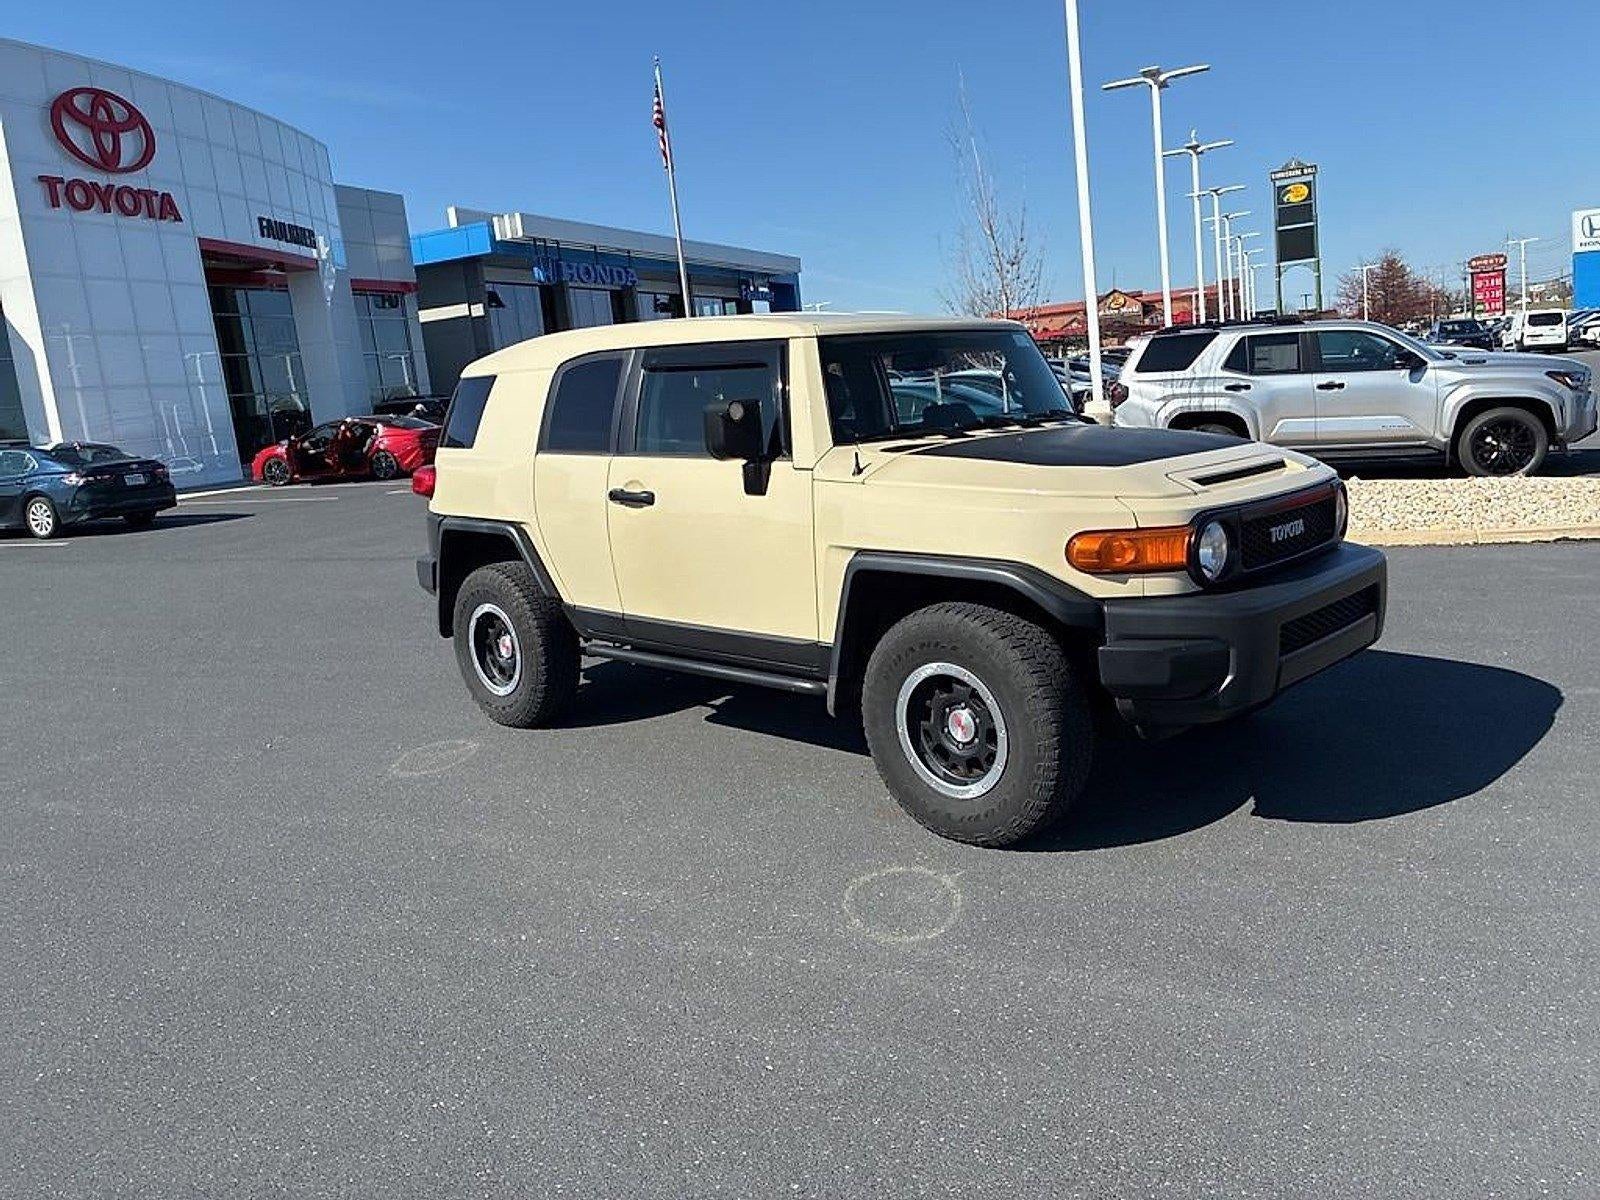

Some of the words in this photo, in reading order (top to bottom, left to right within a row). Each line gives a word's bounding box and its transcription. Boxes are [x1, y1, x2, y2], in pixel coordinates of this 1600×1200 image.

[38, 175, 183, 222] TOYOTA
[558, 261, 638, 286] HONDA
[1270, 518, 1304, 543] TOYOTA
